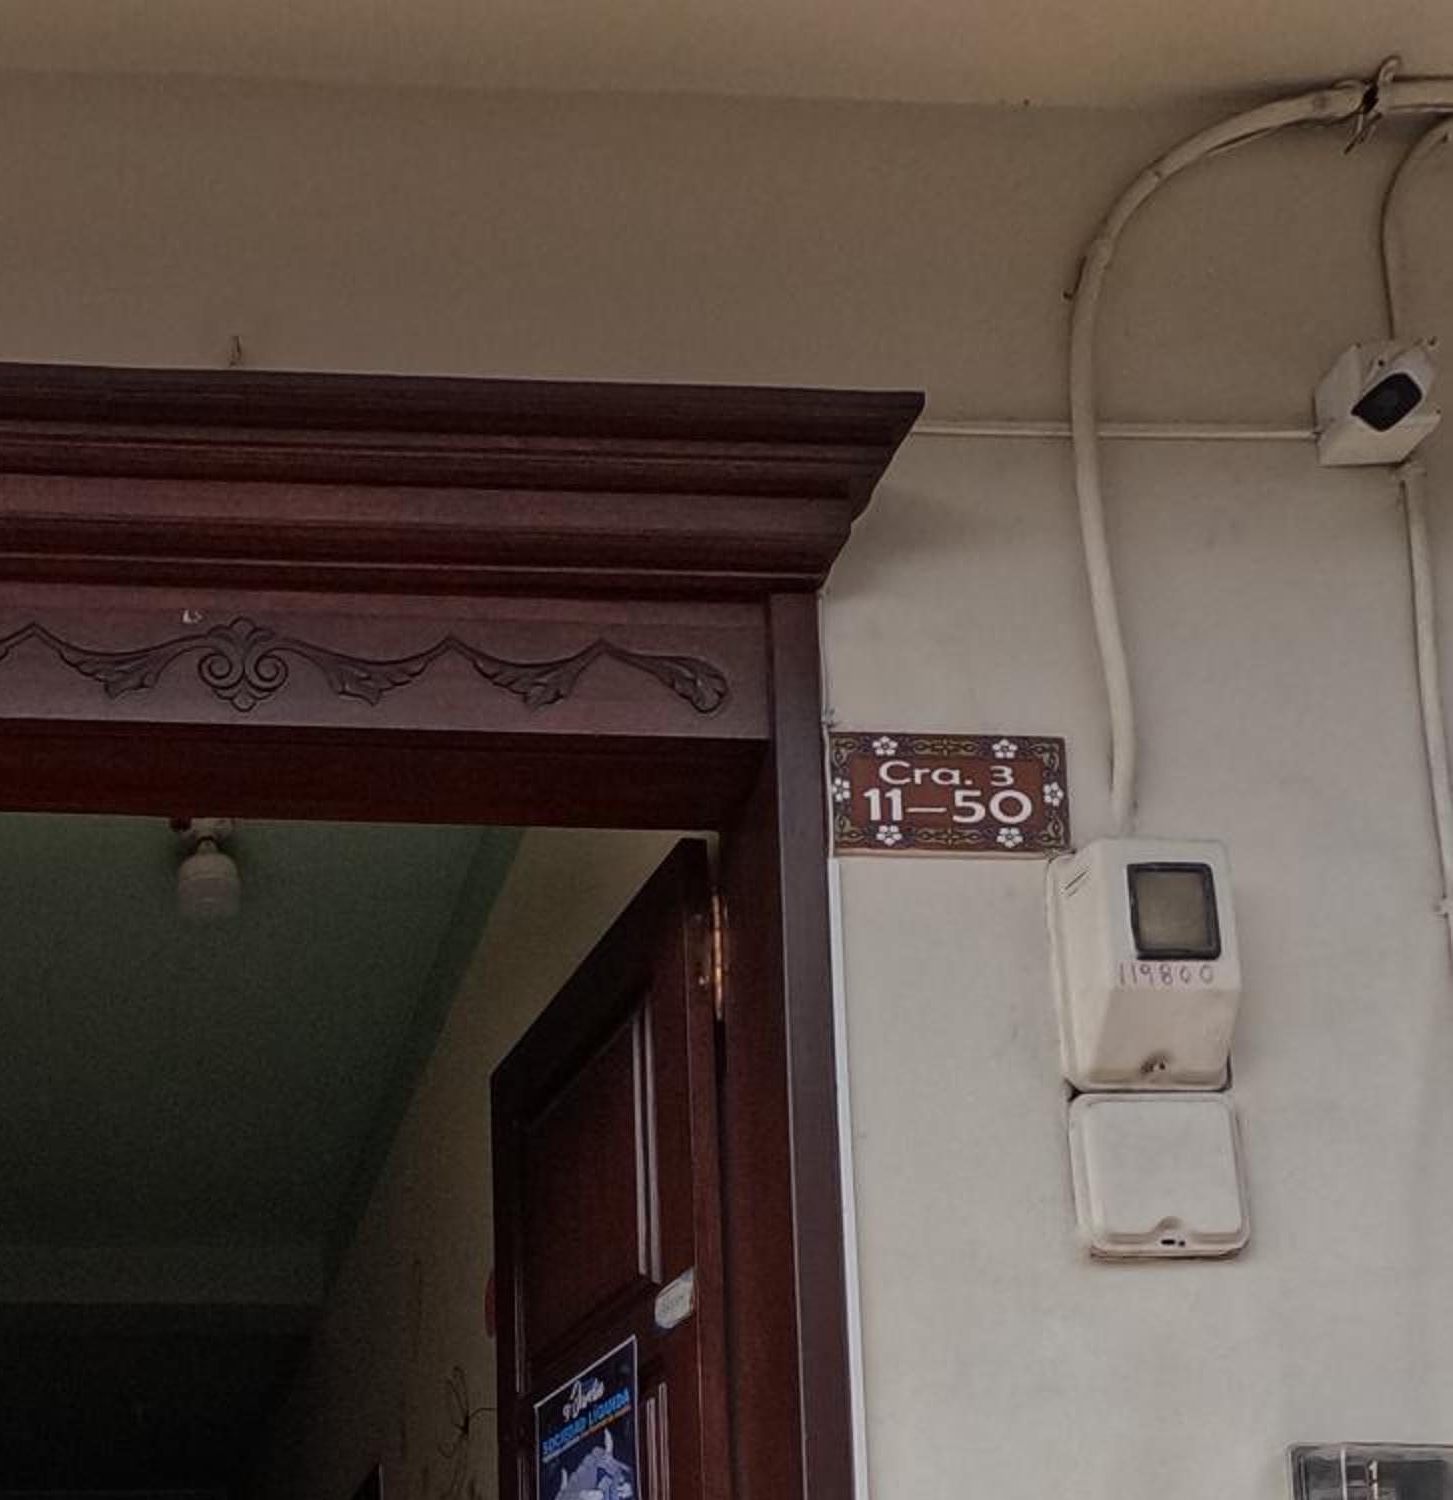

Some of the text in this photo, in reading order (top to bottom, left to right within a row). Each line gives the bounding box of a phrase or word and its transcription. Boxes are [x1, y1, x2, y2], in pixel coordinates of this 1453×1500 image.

[878, 759, 1015, 787] Cra. 3
[863, 787, 1033, 824] 11-50
[1119, 963, 1215, 986] 119800
